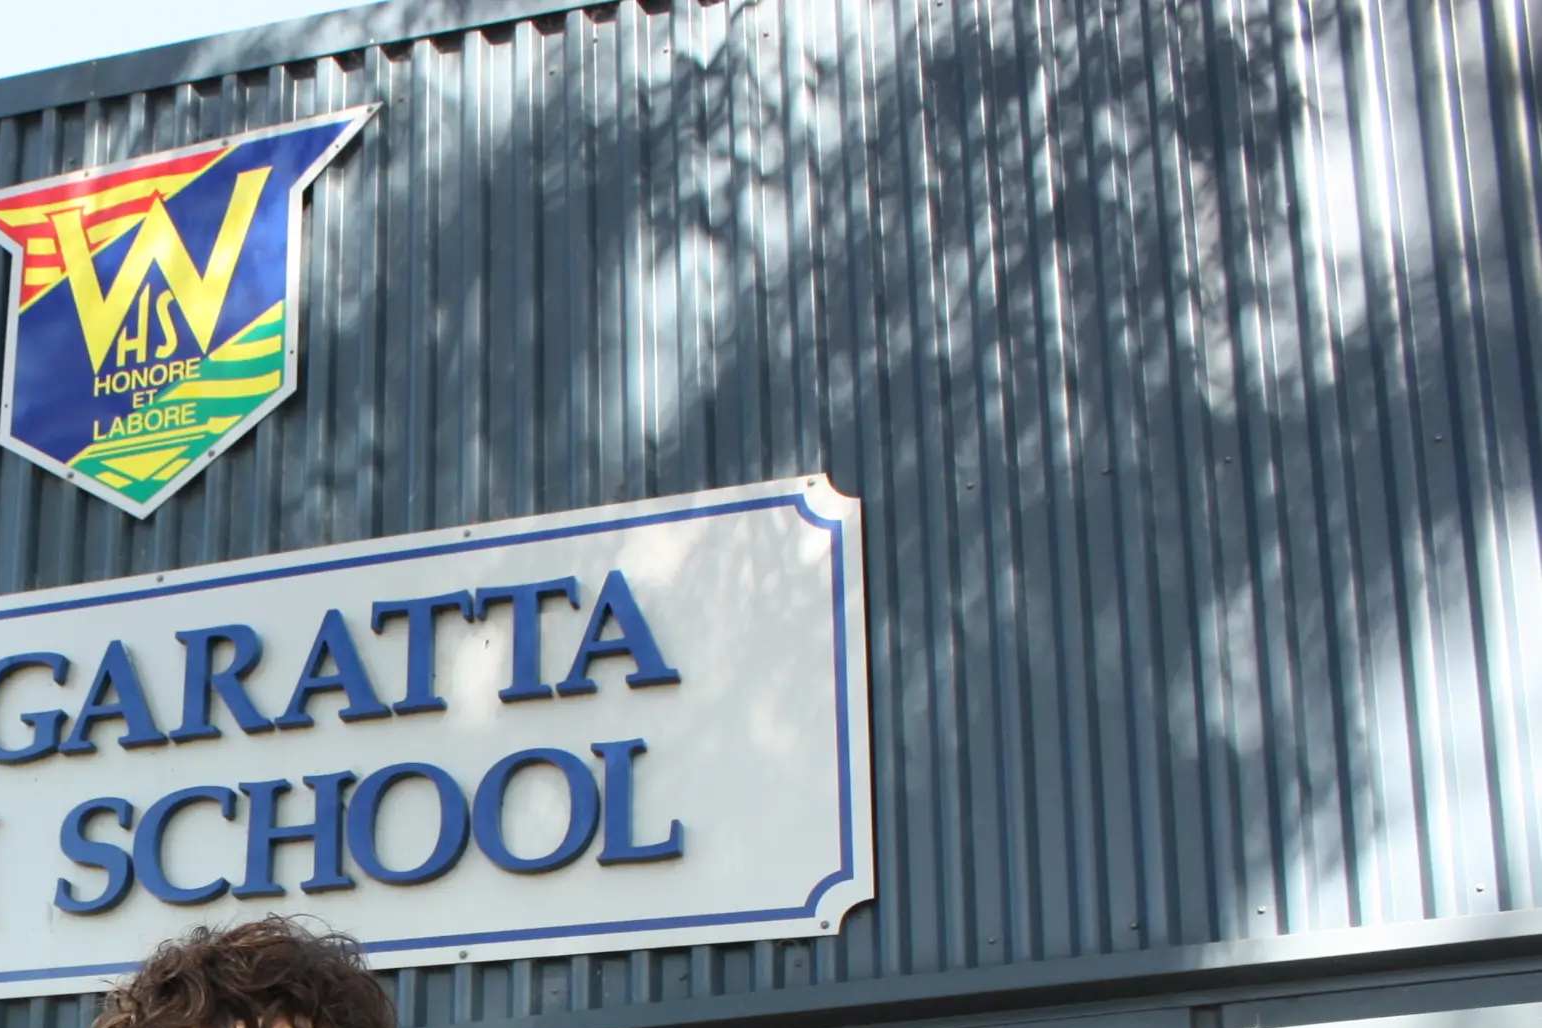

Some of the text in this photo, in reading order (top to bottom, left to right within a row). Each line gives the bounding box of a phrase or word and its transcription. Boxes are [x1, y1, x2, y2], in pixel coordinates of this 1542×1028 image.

[92, 356, 201, 397] HONORE
[132, 390, 157, 409] ET
[92, 402, 198, 441] LABORE
[53, 738, 684, 916] SCHOOL
